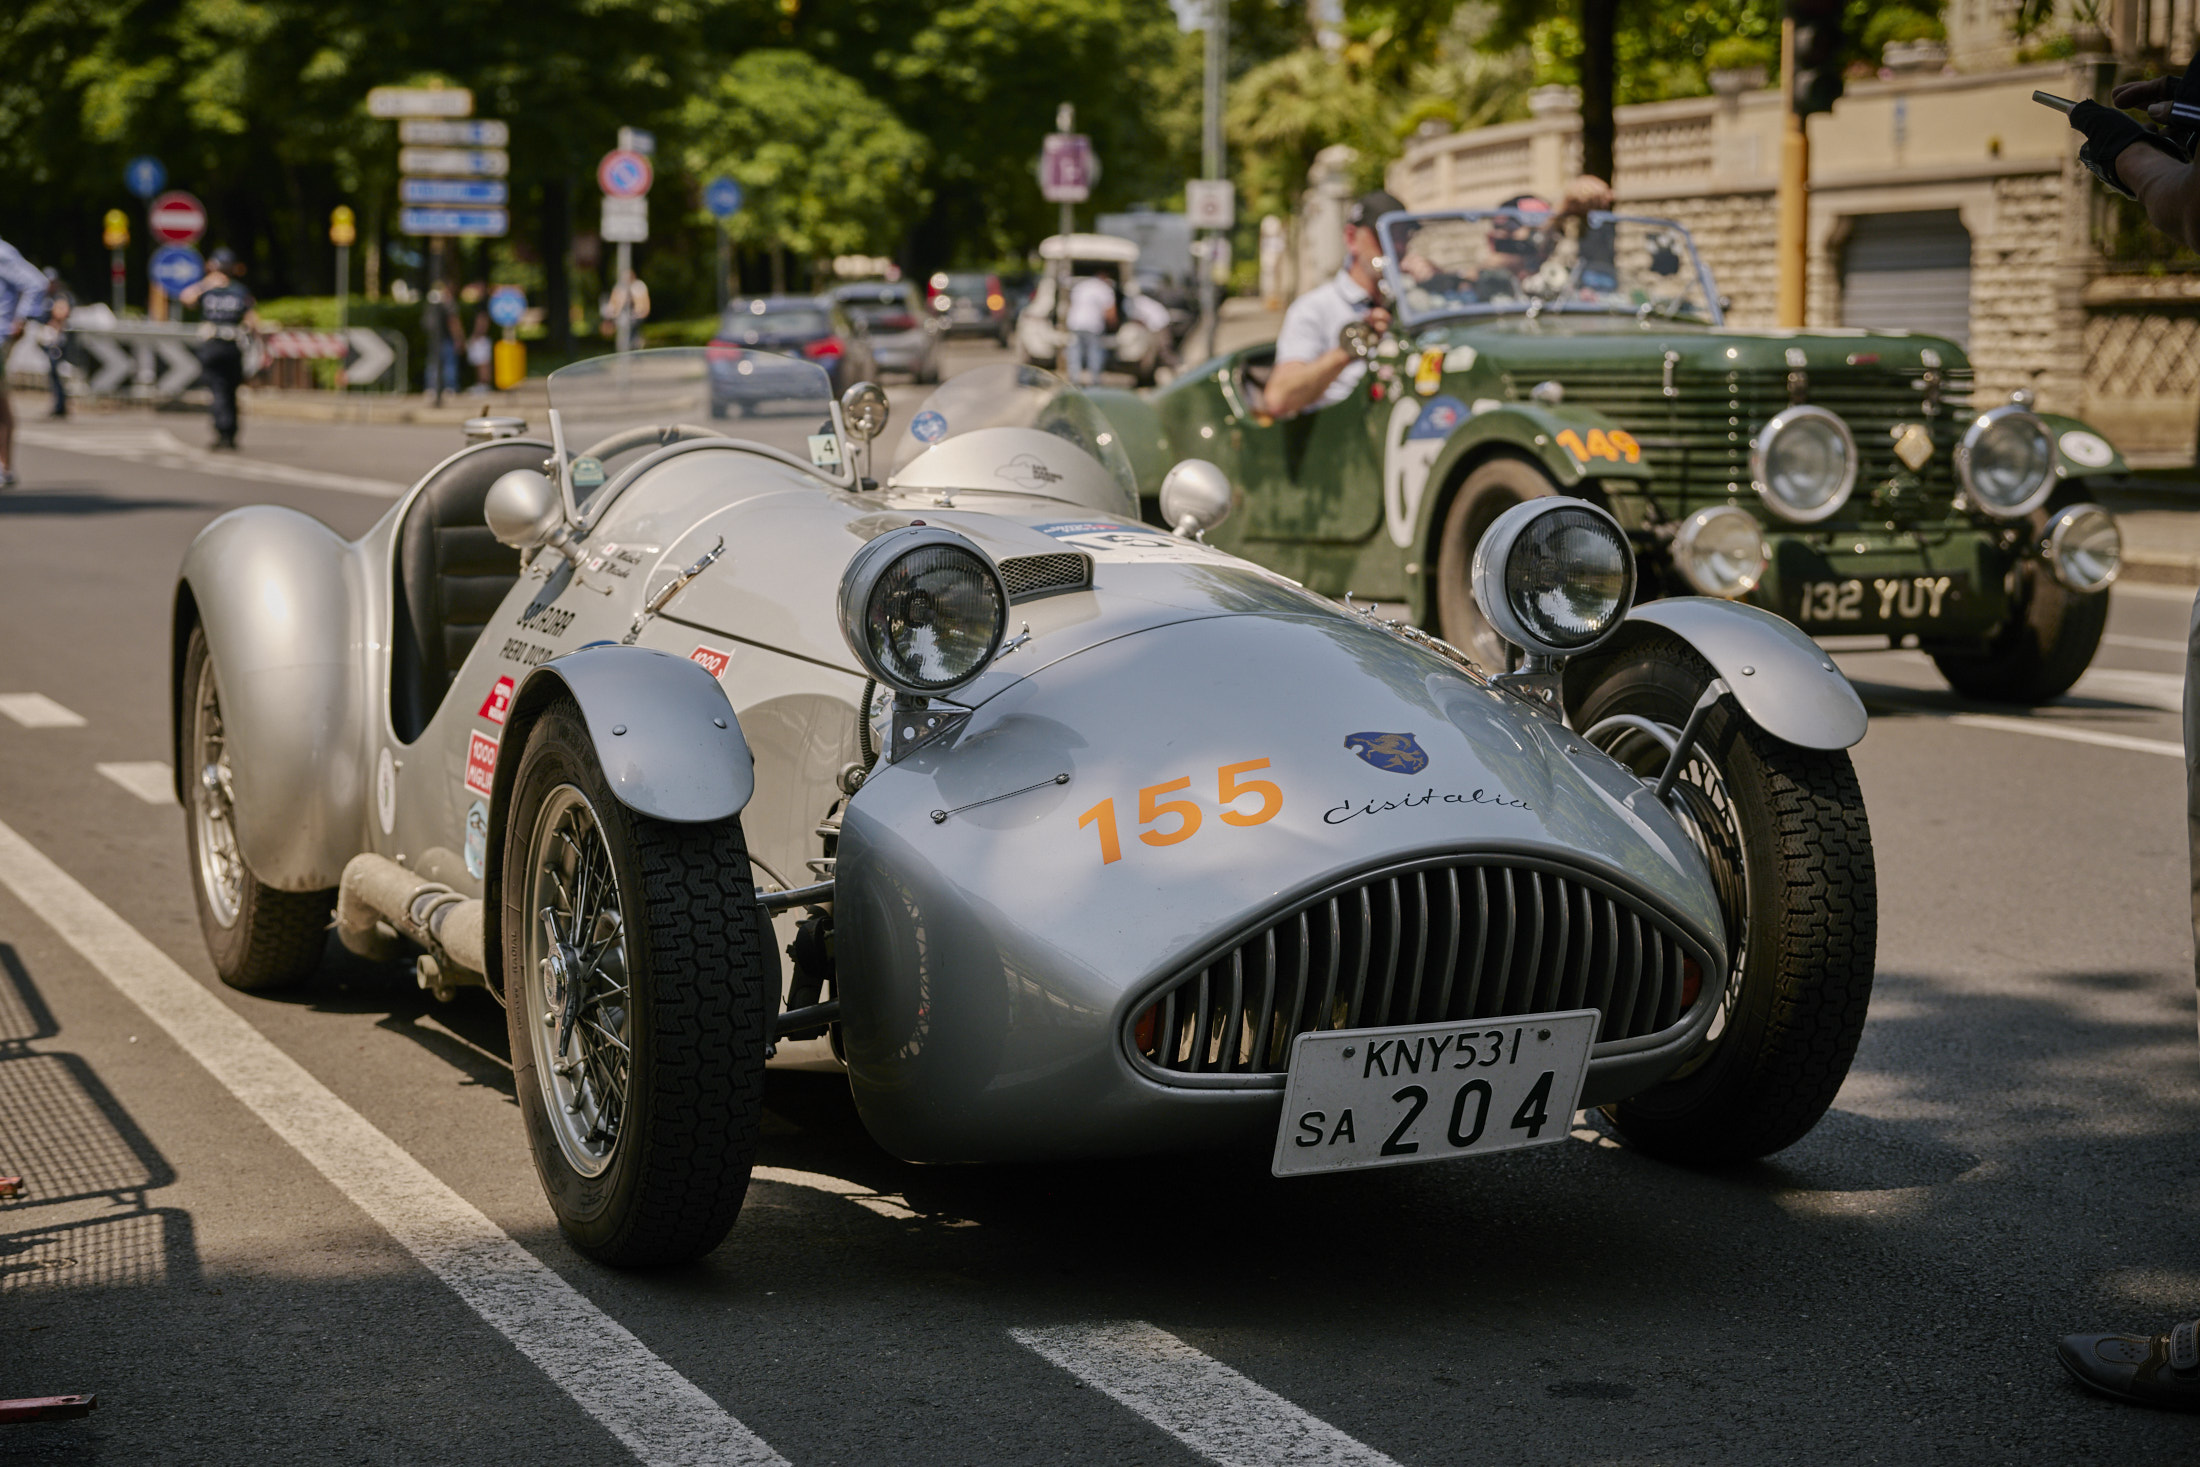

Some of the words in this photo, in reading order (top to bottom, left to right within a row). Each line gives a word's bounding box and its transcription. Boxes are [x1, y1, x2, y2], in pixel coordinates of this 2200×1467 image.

[824, 439, 834, 455] 4
[1556, 428, 1641, 464] 149
[1800, 580, 1864, 622] 132
[1874, 576, 1951, 620] YUY
[694, 651, 722, 671] 1000
[472, 740, 496, 767] 1000
[1079, 757, 1285, 866] 155
[1323, 787, 1533, 826] Cisitalia
[1295, 1108, 1356, 1148] SA
[1380, 1070, 1556, 1157] 204
